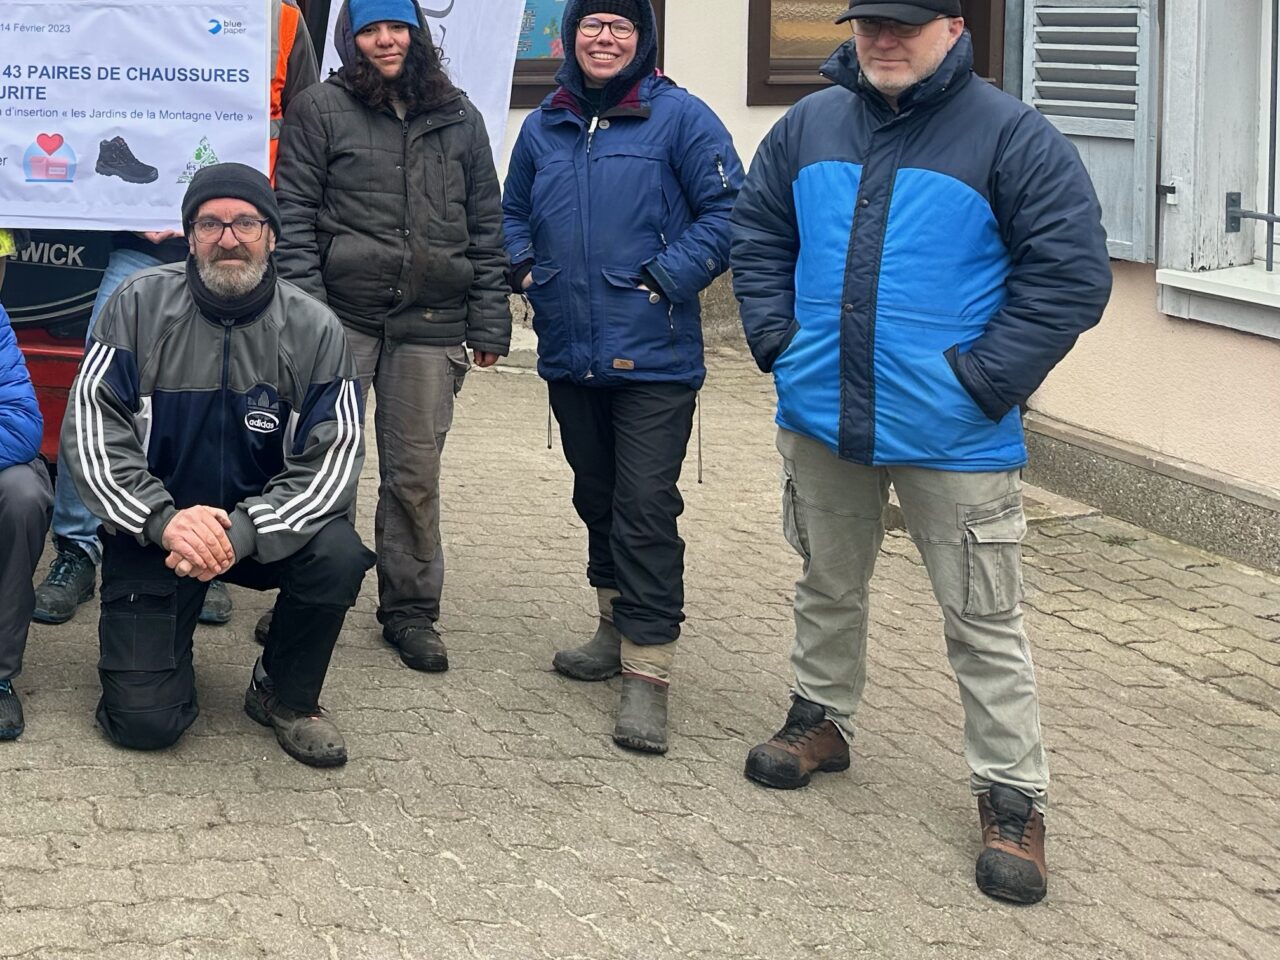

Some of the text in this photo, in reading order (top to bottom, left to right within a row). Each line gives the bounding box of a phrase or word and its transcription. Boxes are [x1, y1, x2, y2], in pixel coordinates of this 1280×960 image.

[0, 23, 11, 32] 14
[13, 22, 45, 33] Février
[47, 23, 71, 33] 2023
[223, 19, 242, 28] blue
[223, 27, 247, 35] paper
[2, 64, 22, 79] 43
[27, 65, 92, 80] PAIRES
[97, 66, 121, 81] DE
[126, 66, 250, 83] CHAUSSURES
[71, 108, 87, 118] les
[89, 108, 127, 119] Jardins
[130, 109, 144, 119] de
[146, 109, 156, 119] la
[159, 109, 212, 123] Montagne
[214, 110, 244, 121] Verte
[10, 241, 86, 267] WICK
[248, 418, 275, 429] adidas
